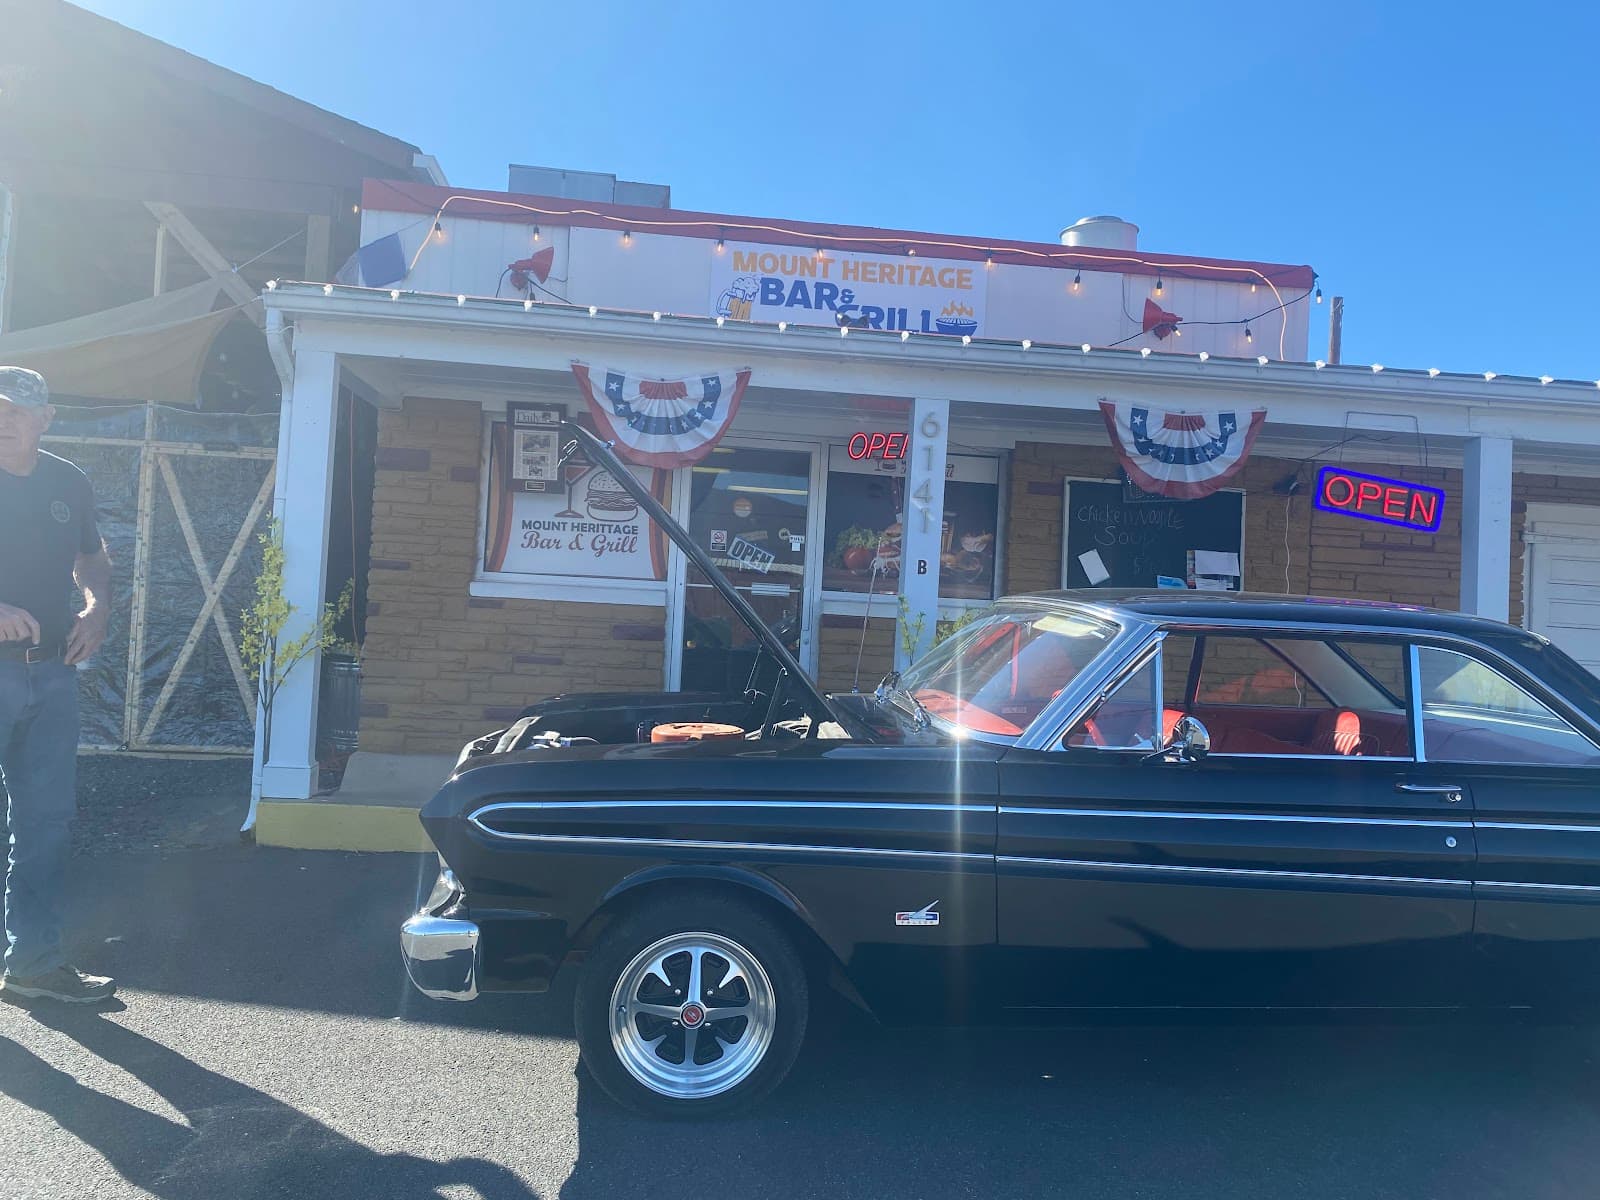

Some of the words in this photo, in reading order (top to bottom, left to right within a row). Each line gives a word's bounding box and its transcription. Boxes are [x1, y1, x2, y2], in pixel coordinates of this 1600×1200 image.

[733, 251, 836, 278] MOUNT
[843, 260, 973, 289] HERITAGE
[912, 411, 941, 535] 6141
[1325, 476, 1436, 524] OPEN
[521, 519, 568, 532] MOUNT
[520, 530, 562, 550] Bar
[568, 533, 585, 551] &
[590, 533, 639, 558] Grill
[731, 540, 772, 569] OPEN
[917, 559, 928, 575] B
